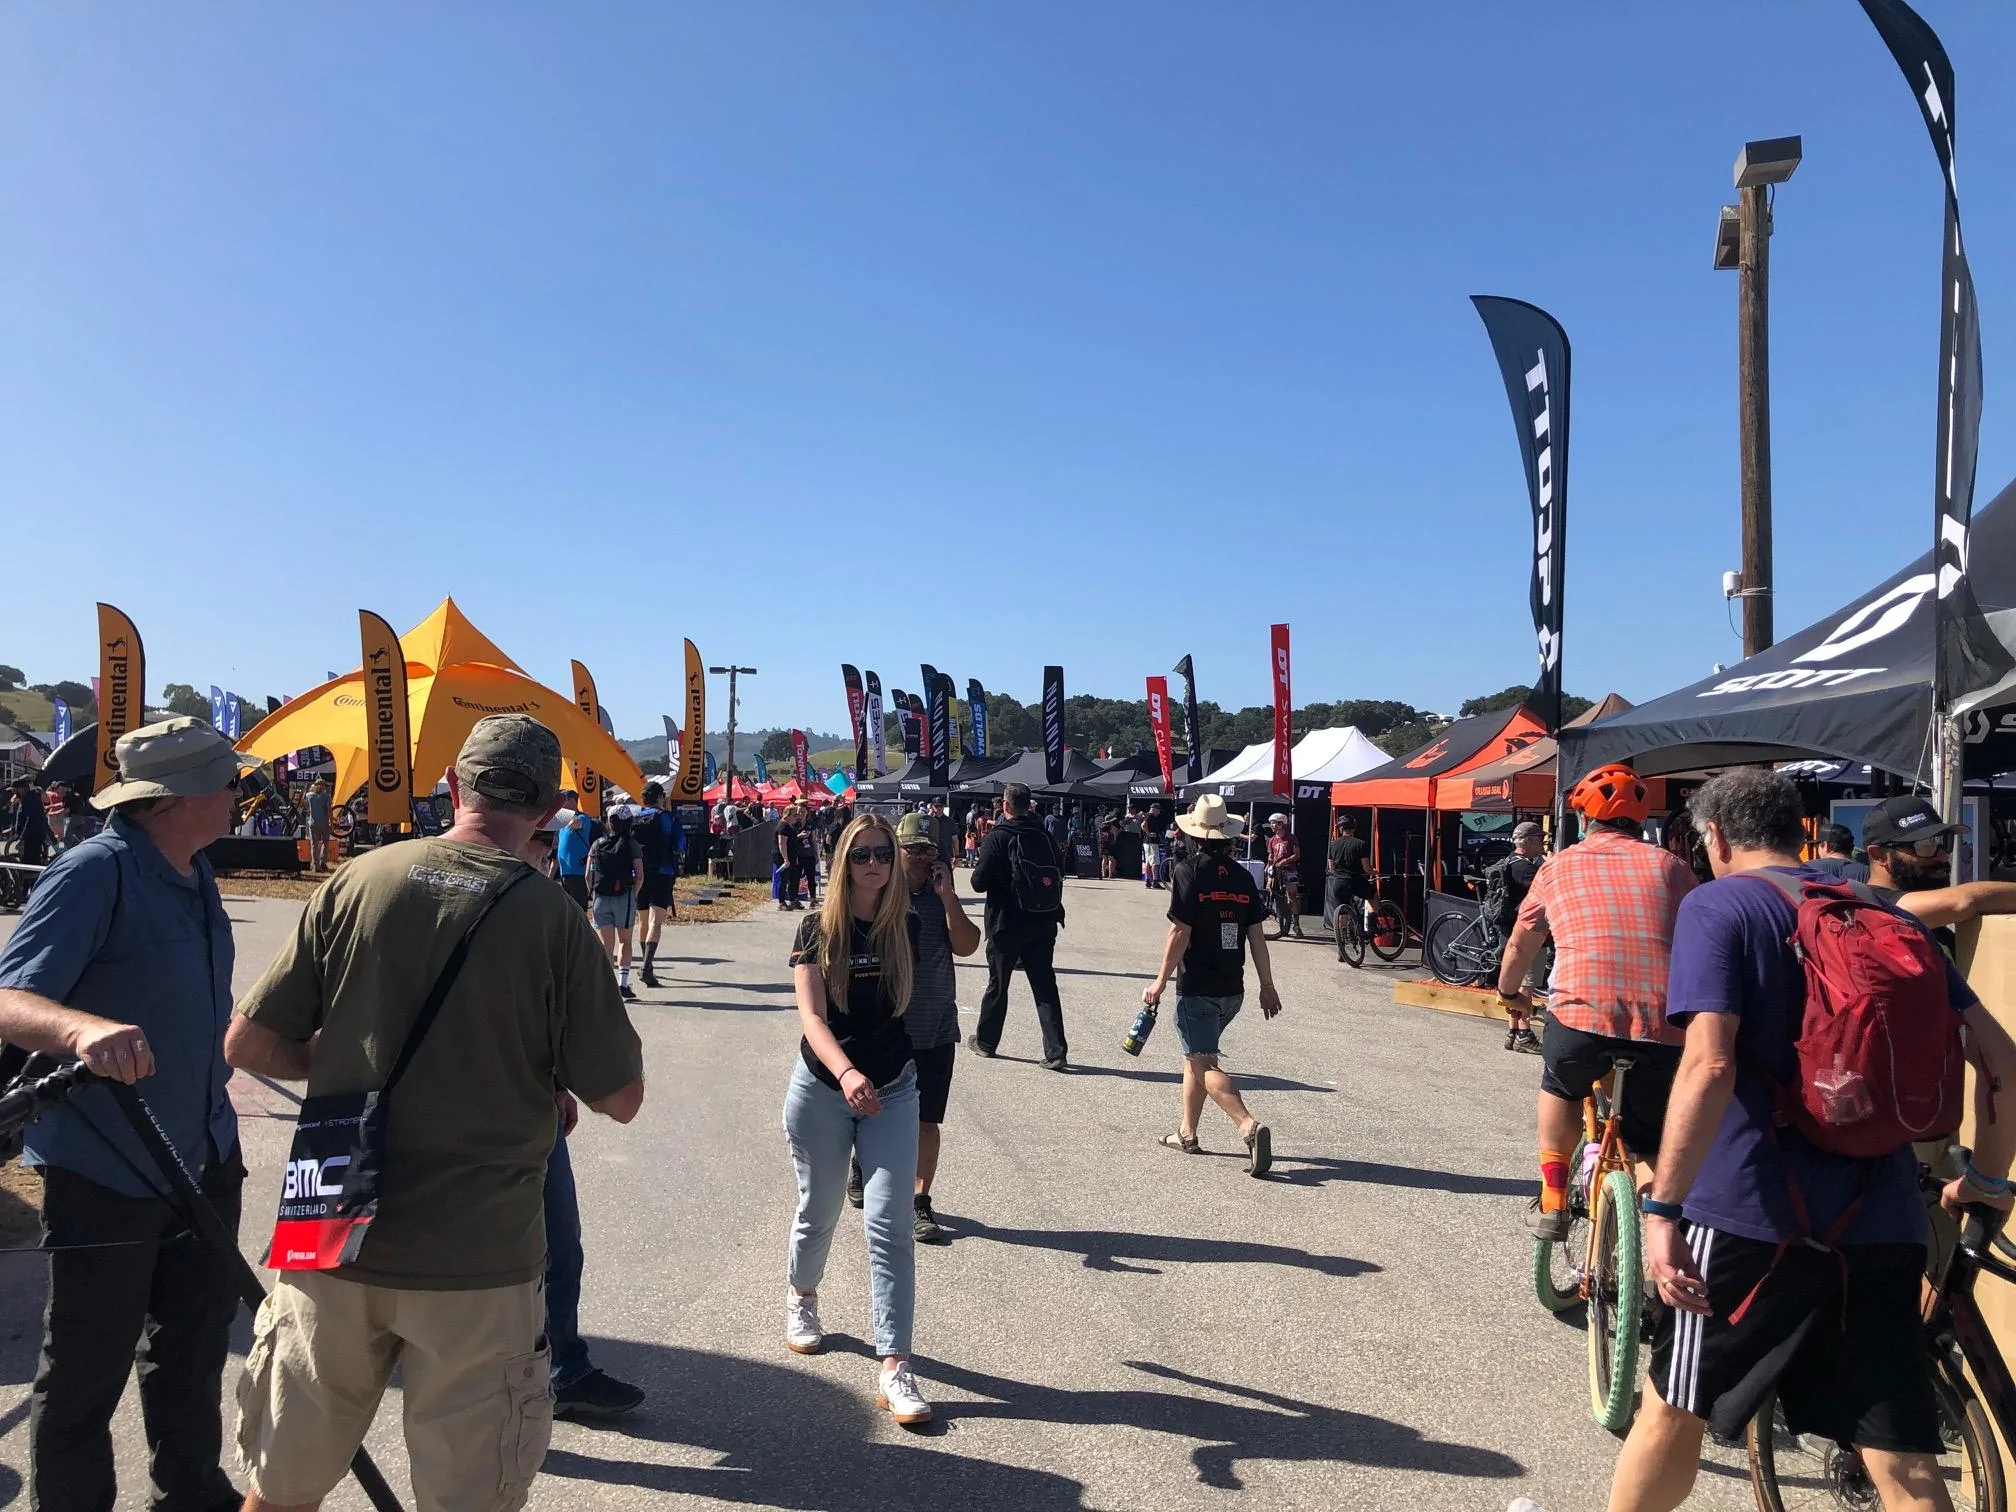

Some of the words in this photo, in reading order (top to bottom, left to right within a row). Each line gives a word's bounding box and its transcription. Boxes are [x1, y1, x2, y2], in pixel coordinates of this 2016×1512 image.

[1277, 647, 1288, 691] DT
[1696, 667, 1889, 698] SCOTT
[452, 696, 529, 714] Continental
[1151, 692, 1163, 724] DT
[371, 667, 401, 793] Continental
[973, 703, 986, 756] YNOLDS
[1045, 680, 1059, 767] CANYON
[681, 689, 701, 795] Continental
[296, 771, 322, 780] BETA
[1130, 785, 1160, 794] CANYON
[1297, 785, 1324, 799] DT
[1198, 891, 1250, 904] HEAD
[284, 1155, 351, 1199] BMC
[279, 1203, 328, 1217] SWITZERLAND
